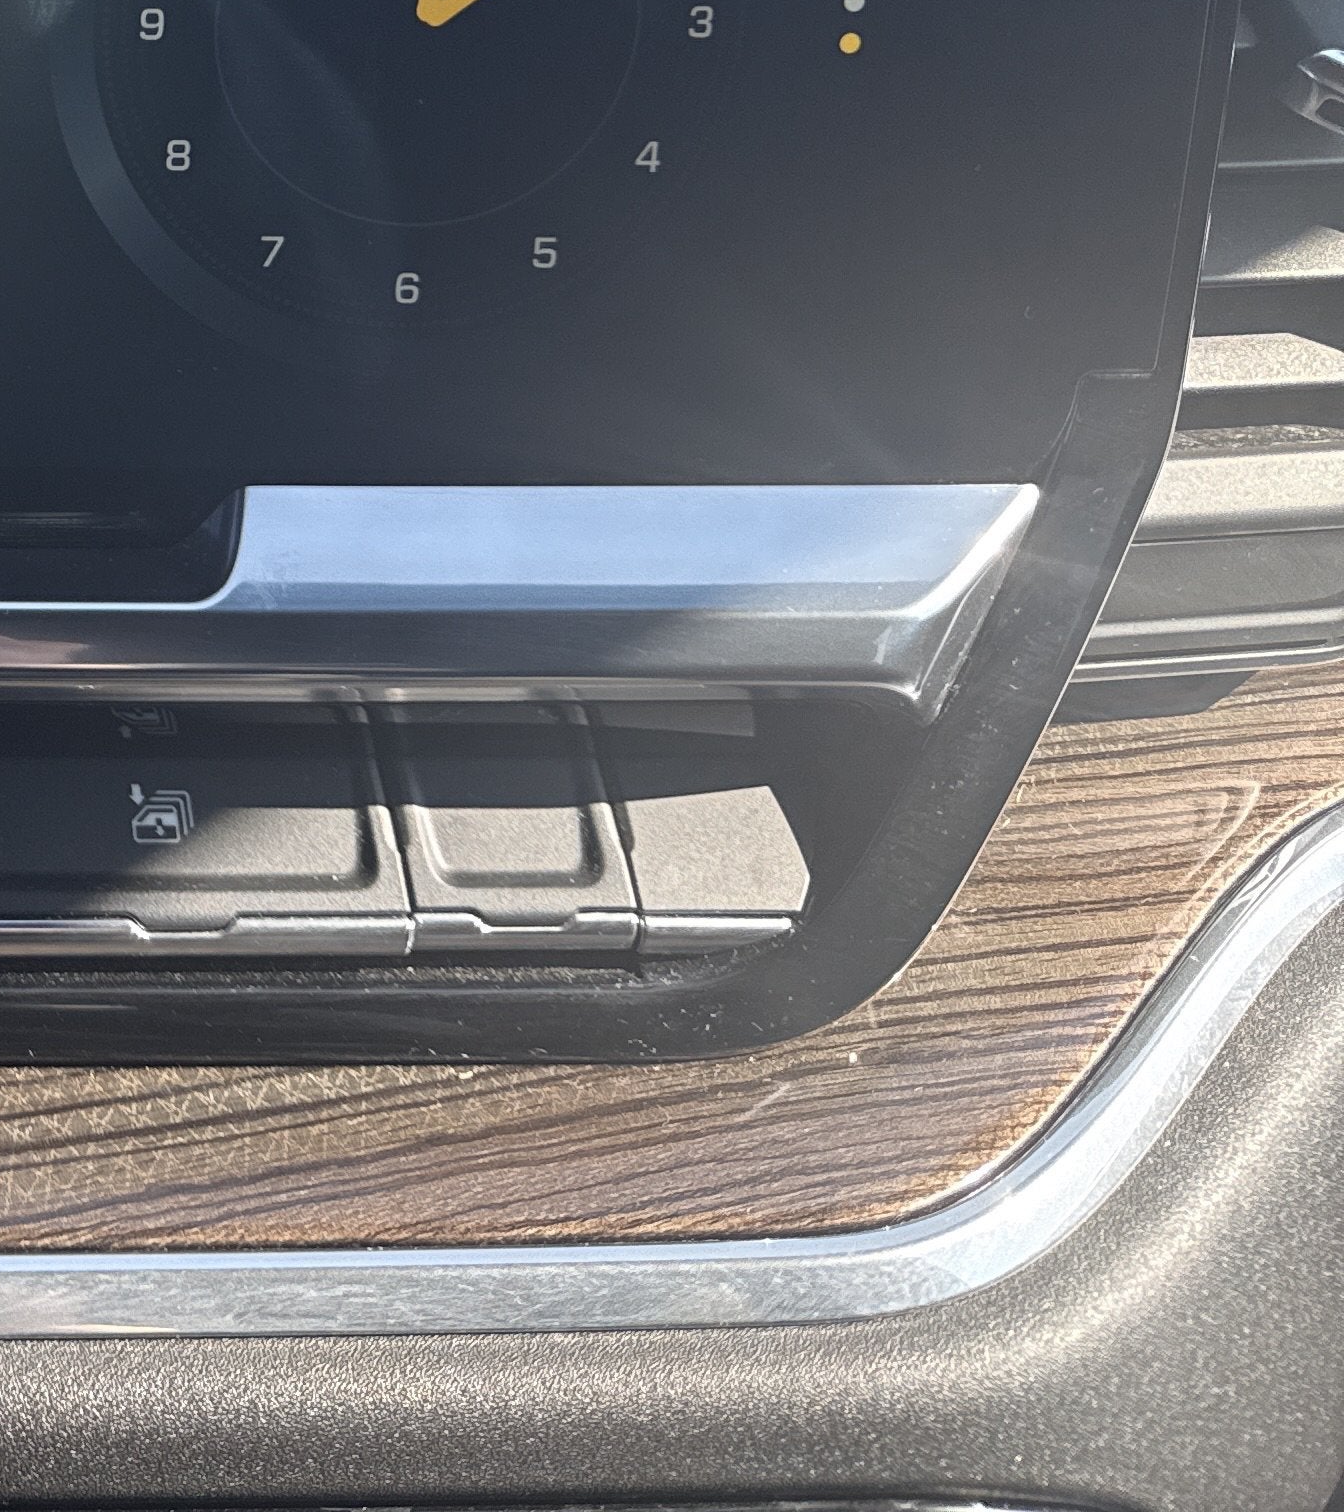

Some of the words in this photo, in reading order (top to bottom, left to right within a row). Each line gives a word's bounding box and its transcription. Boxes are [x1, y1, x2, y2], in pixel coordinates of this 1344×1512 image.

[139, 8, 165, 41] 9
[688, 5, 714, 39] 3
[165, 139, 191, 172] 8
[634, 140, 661, 173] 4
[260, 235, 285, 268] 7
[532, 236, 557, 269] 5
[395, 272, 420, 304] 6
